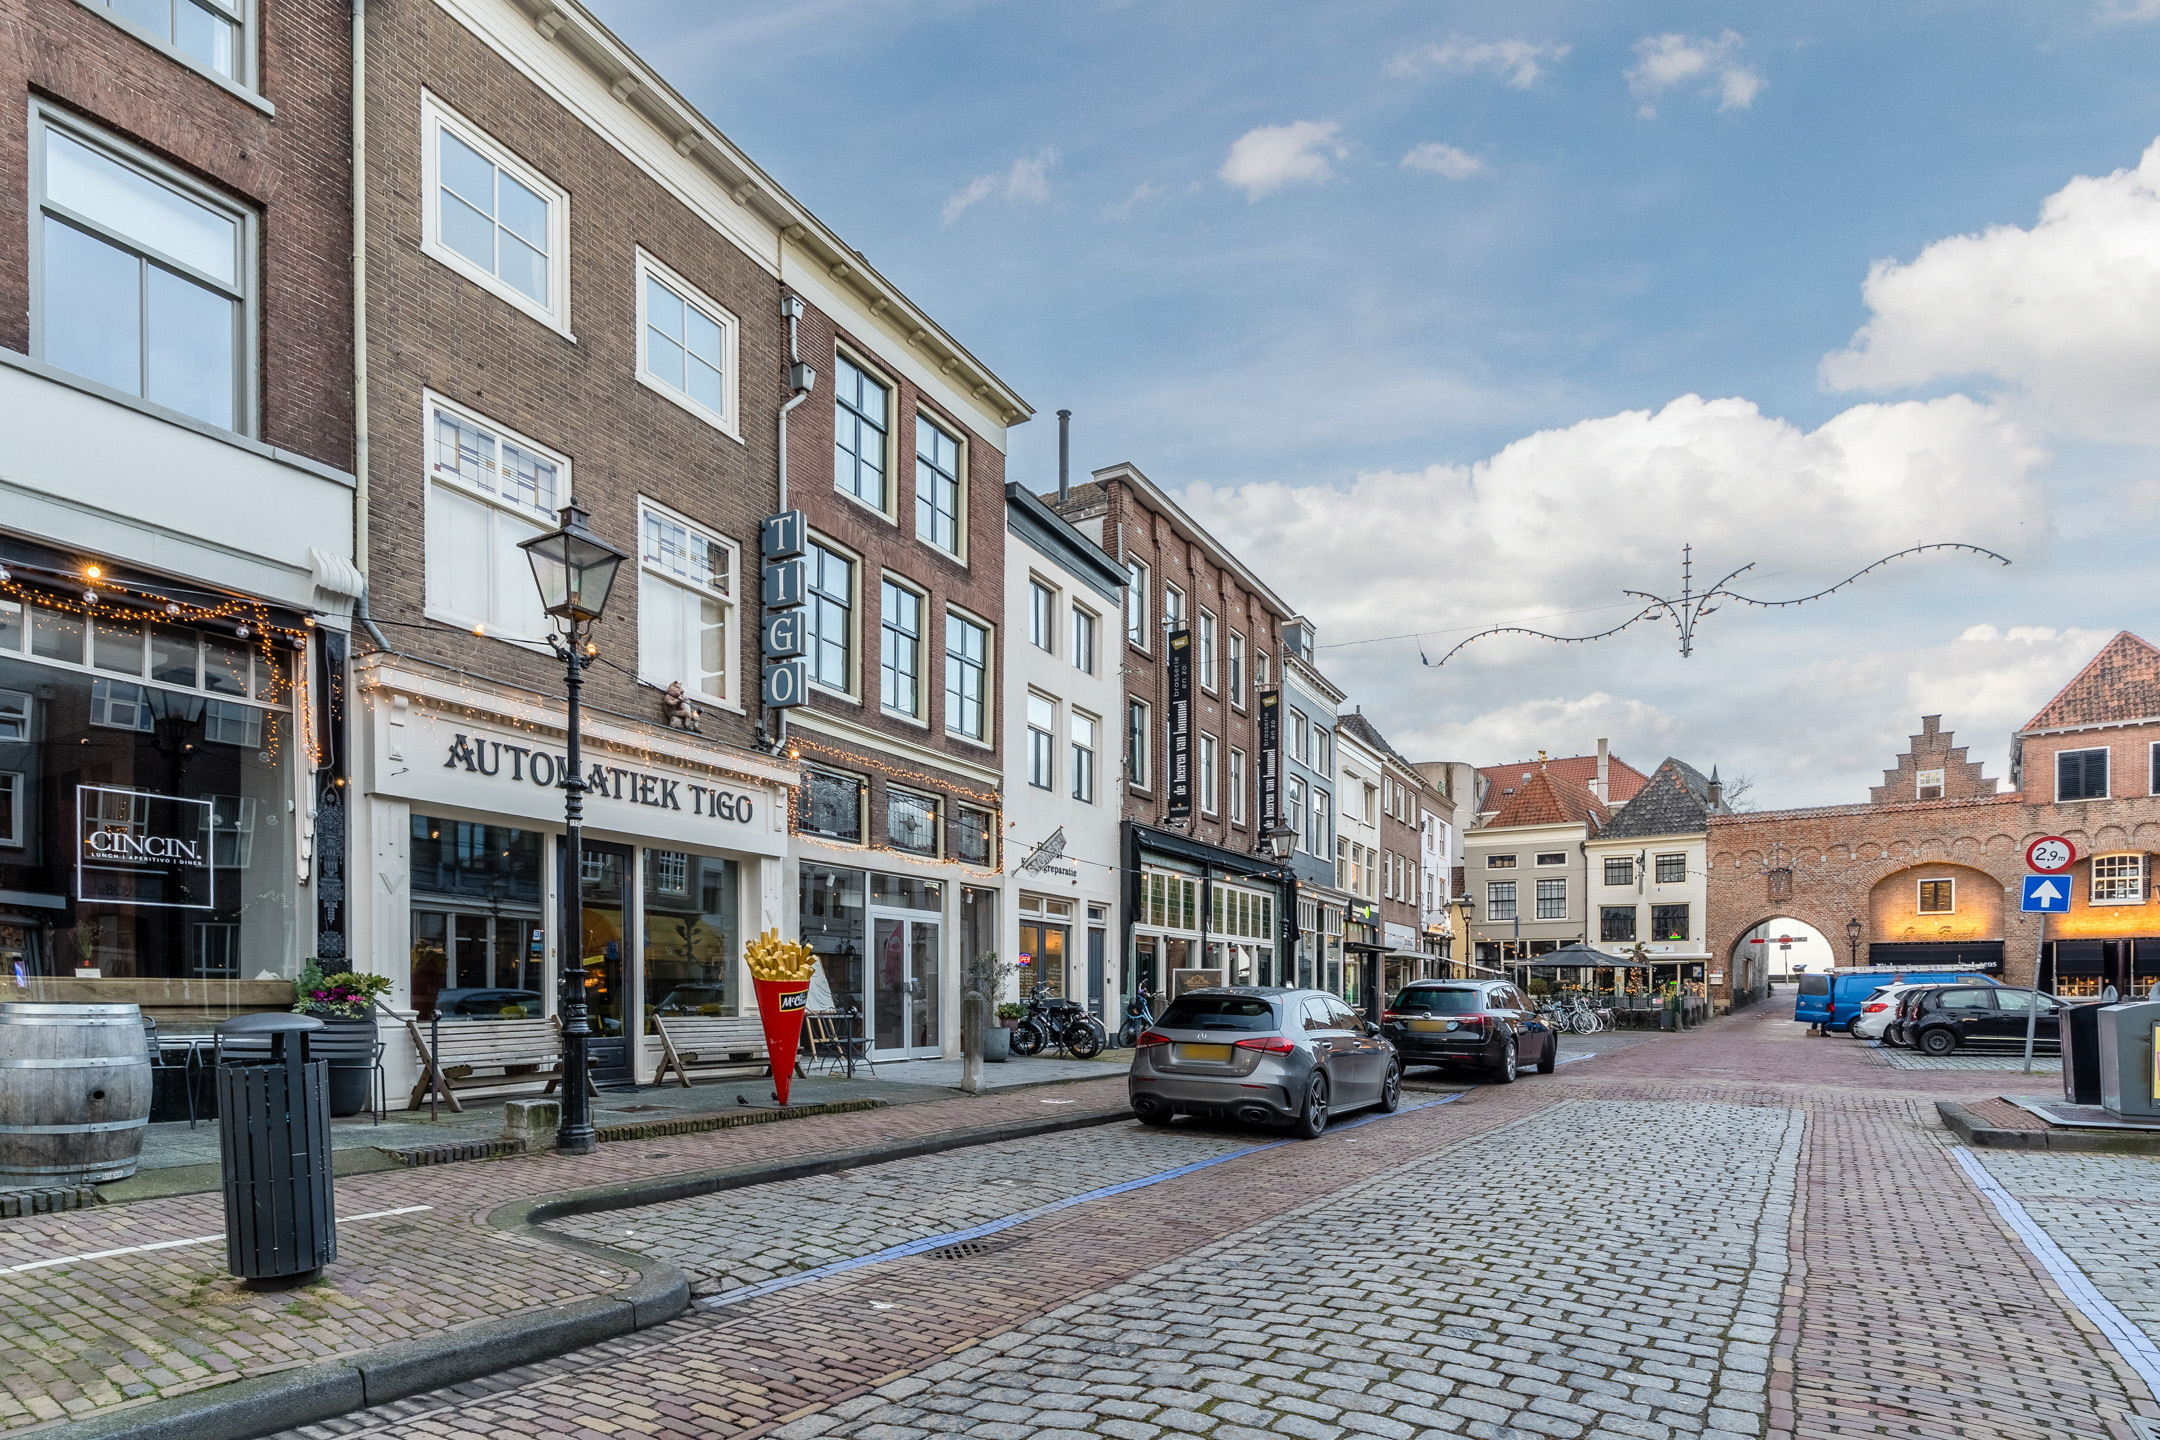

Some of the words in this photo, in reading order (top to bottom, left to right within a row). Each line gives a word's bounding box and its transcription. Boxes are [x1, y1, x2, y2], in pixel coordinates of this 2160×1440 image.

[769, 515, 793, 701] TIGO
[1172, 656, 1180, 697] brasserie
[1181, 665, 1187, 676] zo
[1181, 677, 1187, 689] en
[1172, 700, 1187, 735] bommel
[1270, 720, 1276, 728] zo
[1270, 730, 1276, 740] en
[1176, 736, 1187, 752] van
[1173, 753, 1187, 782] heeren
[1262, 748, 1276, 778] bommel
[1173, 785, 1187, 796] de
[1265, 779, 1275, 792] van
[688, 783, 754, 824] TIGO
[89, 831, 202, 860] CINCIN.
[91, 852, 119, 860] LUNCH
[128, 855, 171, 864] APERITIVO
